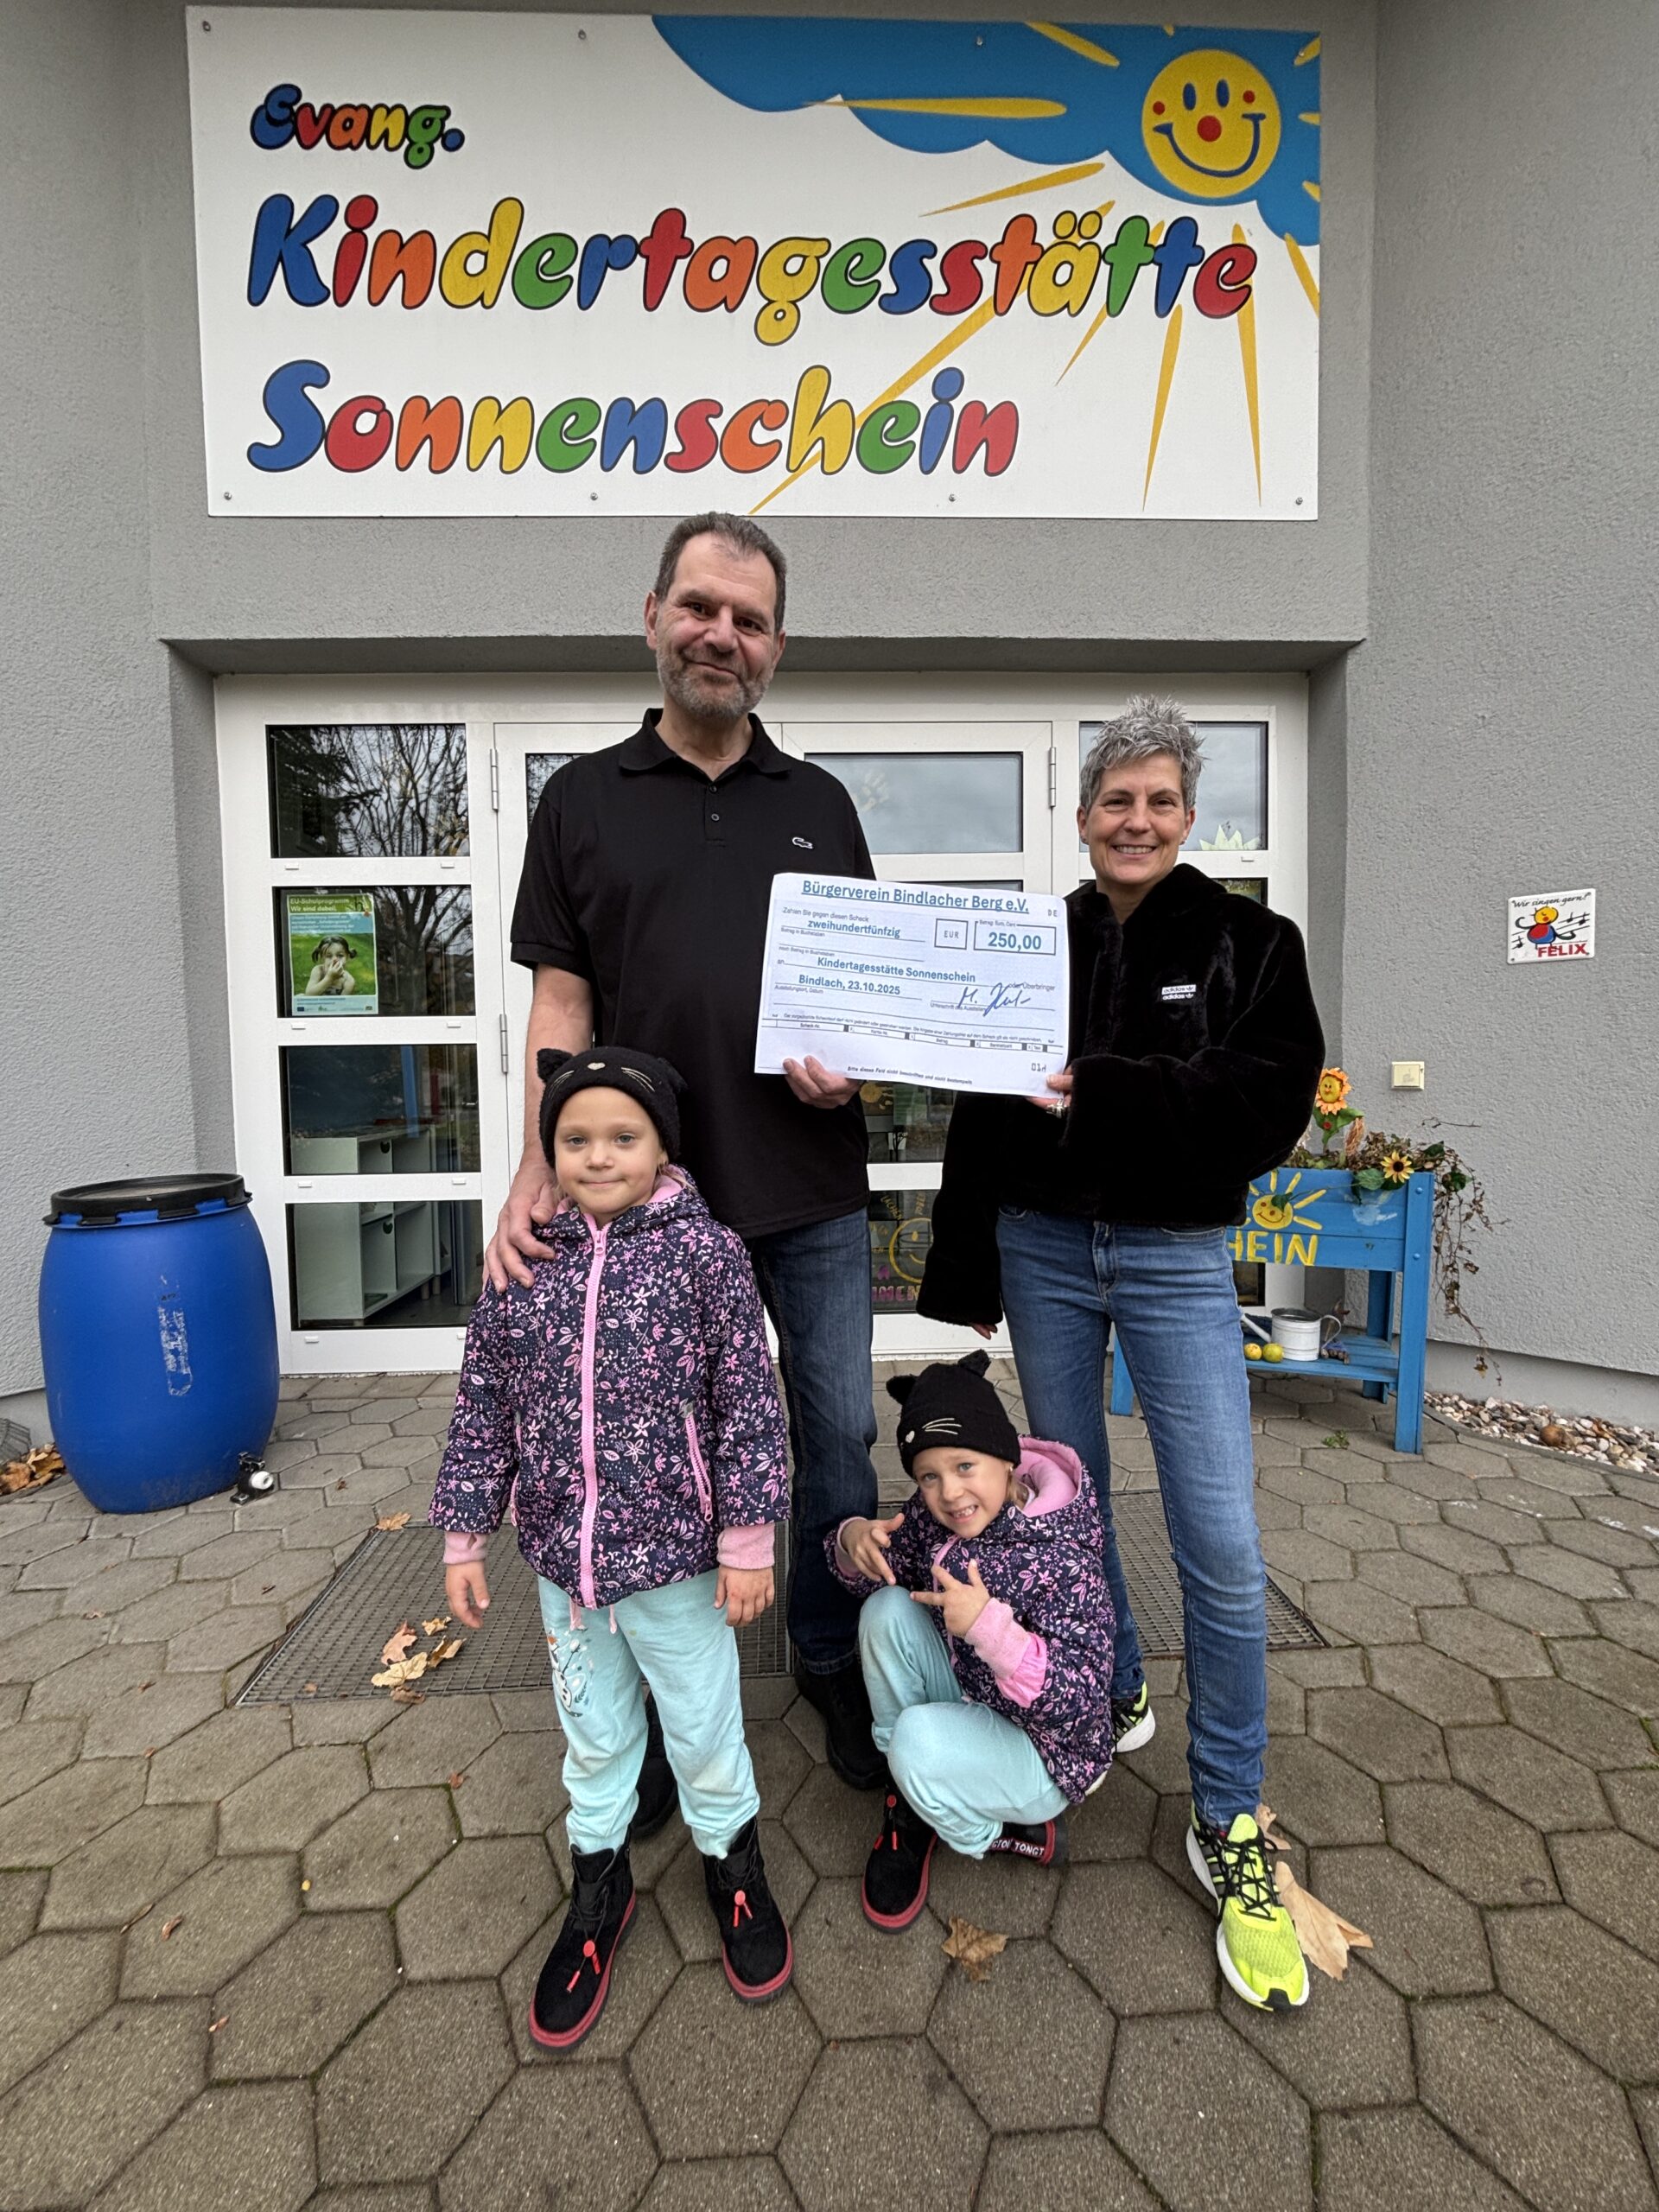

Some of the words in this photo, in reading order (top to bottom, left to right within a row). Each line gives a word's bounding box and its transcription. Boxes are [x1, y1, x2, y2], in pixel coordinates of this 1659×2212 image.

[250, 83, 465, 169] Evang.
[247, 194, 1257, 346] Kindertagesstätte
[247, 359, 1019, 476] Sonnenschein
[803, 880, 890, 901] Bürgerverein
[893, 888, 969, 907] Bindlacher
[972, 895, 1003, 912] Berg
[1006, 898, 1030, 912] e.V.
[1532, 899, 1560, 907] singen
[808, 920, 901, 939] zweihundertfünfzig
[944, 930, 959, 939] EUR
[988, 931, 1042, 951] 250,00
[1538, 943, 1586, 958] FELIX
[817, 957, 904, 976] Kindertagesstätte
[906, 967, 976, 982] Sonnenschein
[798, 974, 846, 990] Bindlach,
[848, 980, 900, 995] 23.10.2025
